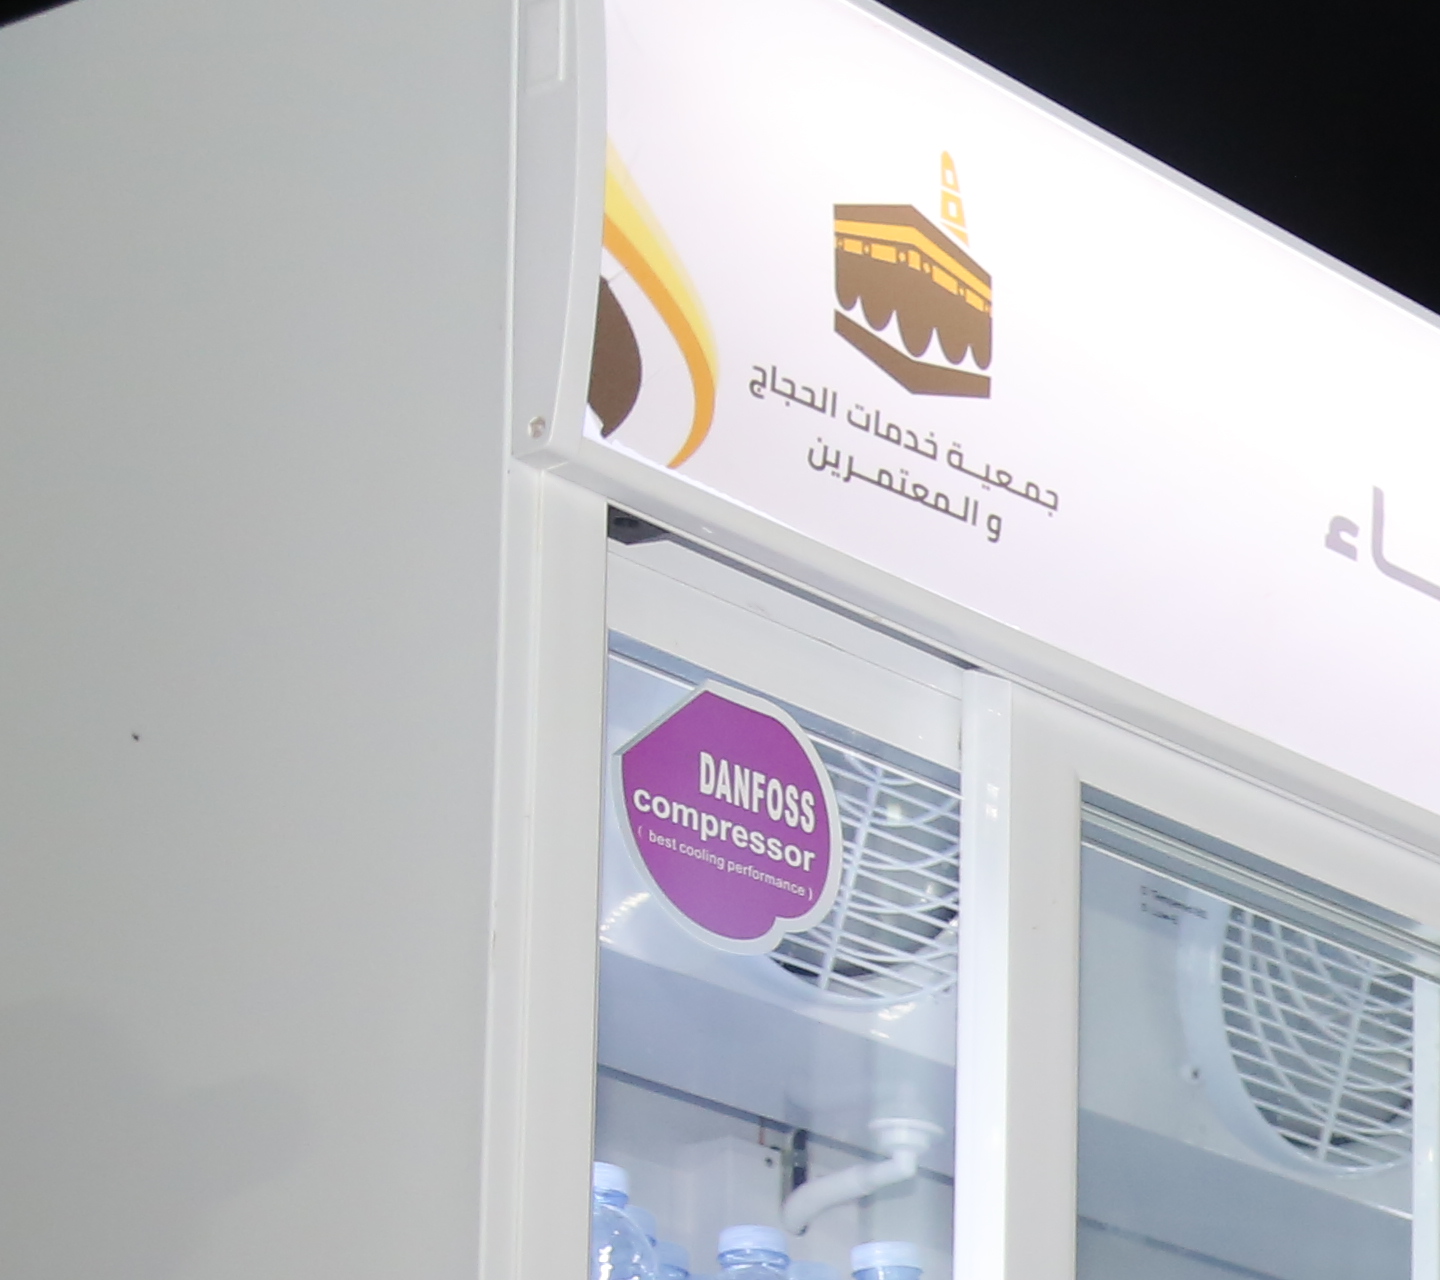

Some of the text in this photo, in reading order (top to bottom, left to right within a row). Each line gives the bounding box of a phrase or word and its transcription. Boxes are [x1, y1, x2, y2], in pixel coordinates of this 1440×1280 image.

[748, 364, 1059, 518] جمعية خدمات الحجاج
[807, 436, 979, 527] المعتمرين
[632, 788, 817, 873] compressor
[698, 750, 816, 835] DANFOSS
[648, 829, 677, 851] best
[679, 842, 726, 871] cooling
[727, 860, 806, 897] performance
